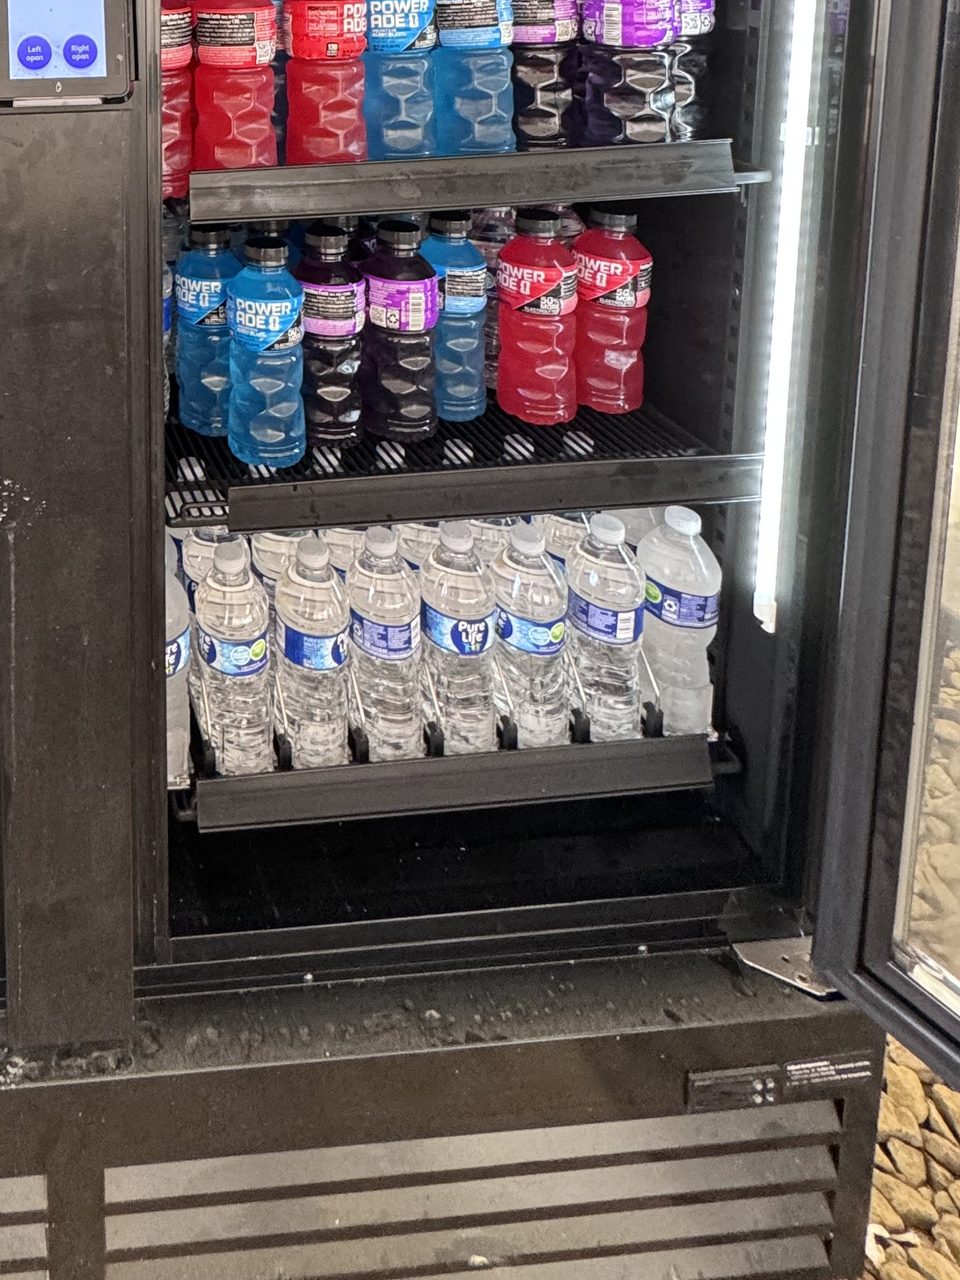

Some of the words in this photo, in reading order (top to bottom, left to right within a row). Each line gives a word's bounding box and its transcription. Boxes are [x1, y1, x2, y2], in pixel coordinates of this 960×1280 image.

[370, 14, 406, 28] ADE
[71, 44, 90, 52] Right
[72, 53, 89, 61] open
[496, 270, 518, 290] ADE
[576, 265, 592, 282] DE
[176, 274, 222, 293] POWER
[176, 286, 196, 304] ADE
[236, 298, 292, 316] POWER
[236, 312, 266, 329] ADE
[458, 620, 486, 634] Pure
[461, 630, 483, 644] Life
